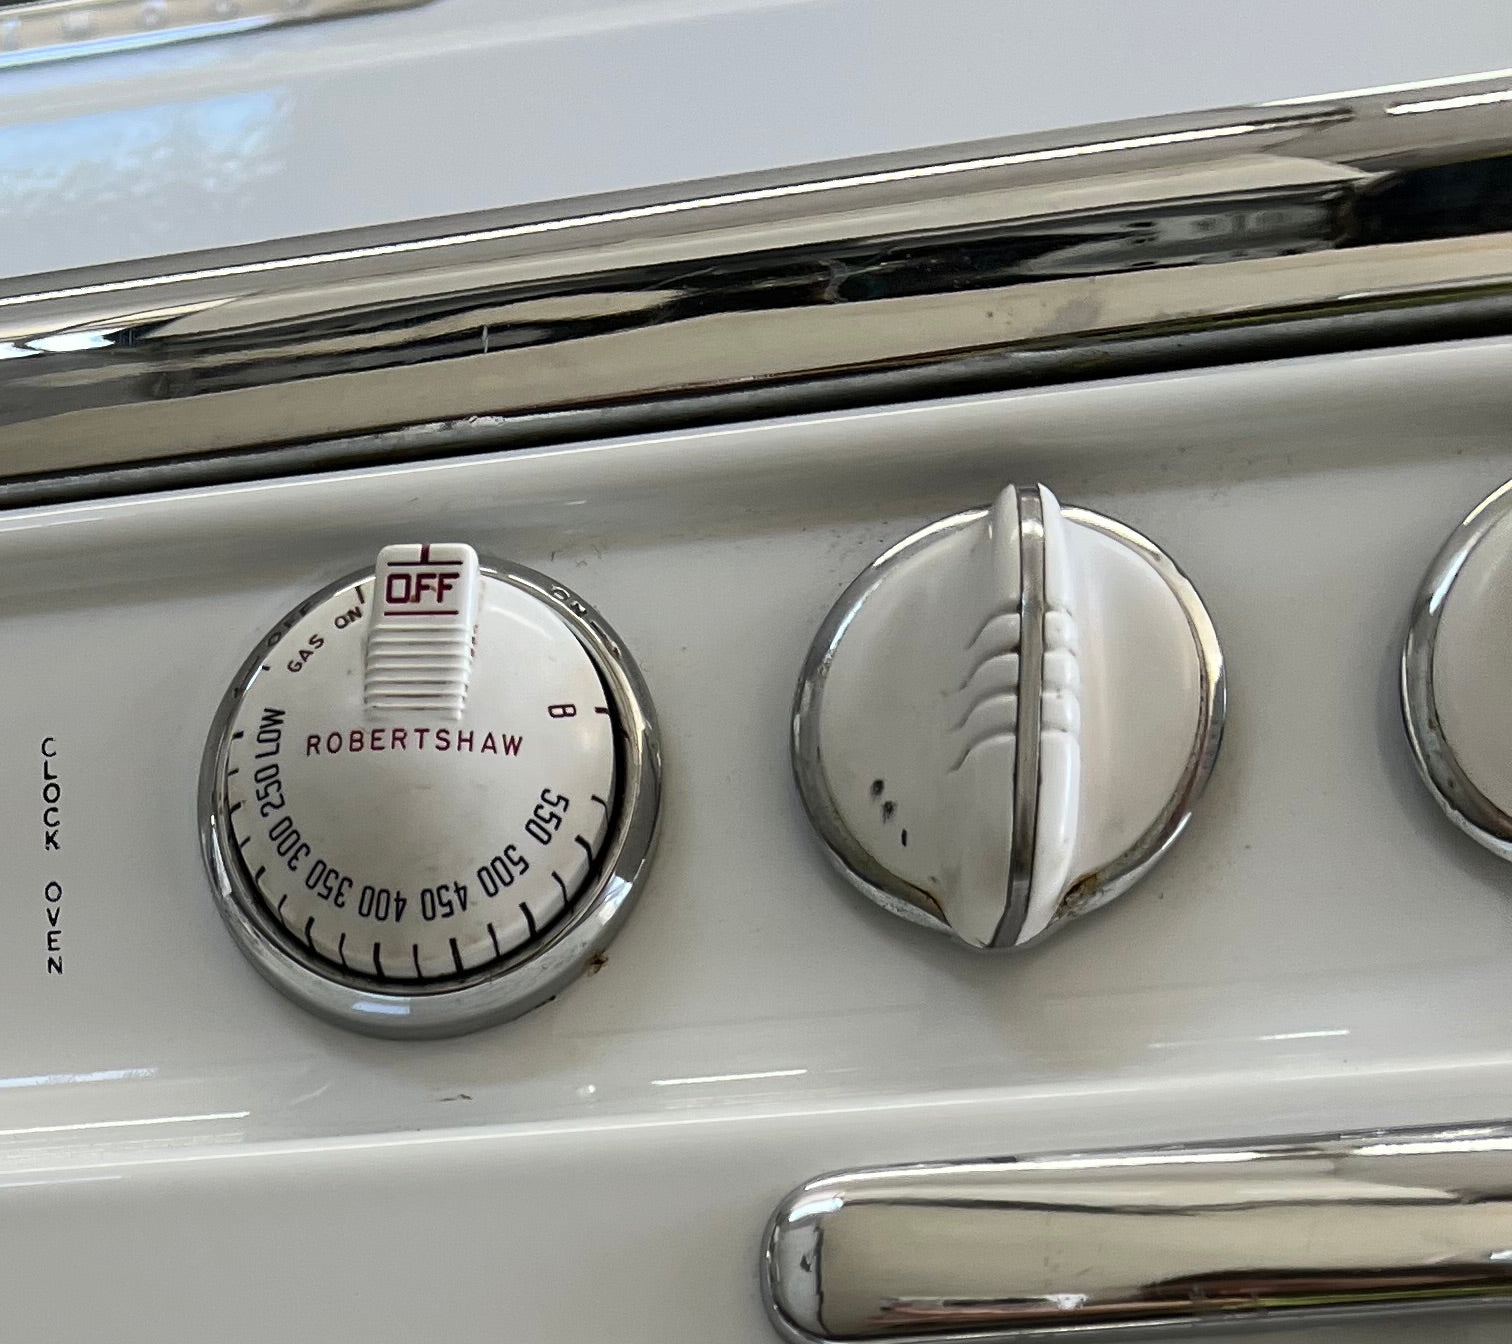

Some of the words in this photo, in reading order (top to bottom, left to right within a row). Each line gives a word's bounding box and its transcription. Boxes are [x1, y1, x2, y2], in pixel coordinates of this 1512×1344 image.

[386, 572, 460, 603] OFF
[287, 634, 324, 673] GAS
[334, 606, 363, 629] ON
[255, 708, 285, 759] LOW
[306, 728, 523, 757] ROBERTSHAW
[41, 737, 61, 850] CLOCK
[254, 764, 285, 817] 250
[525, 788, 570, 845] 550
[269, 816, 311, 871] 300
[305, 860, 353, 908] 350
[477, 844, 529, 897] 500
[358, 886, 407, 922] 400
[420, 880, 467, 921] 450
[44, 881, 63, 974] OVEN
